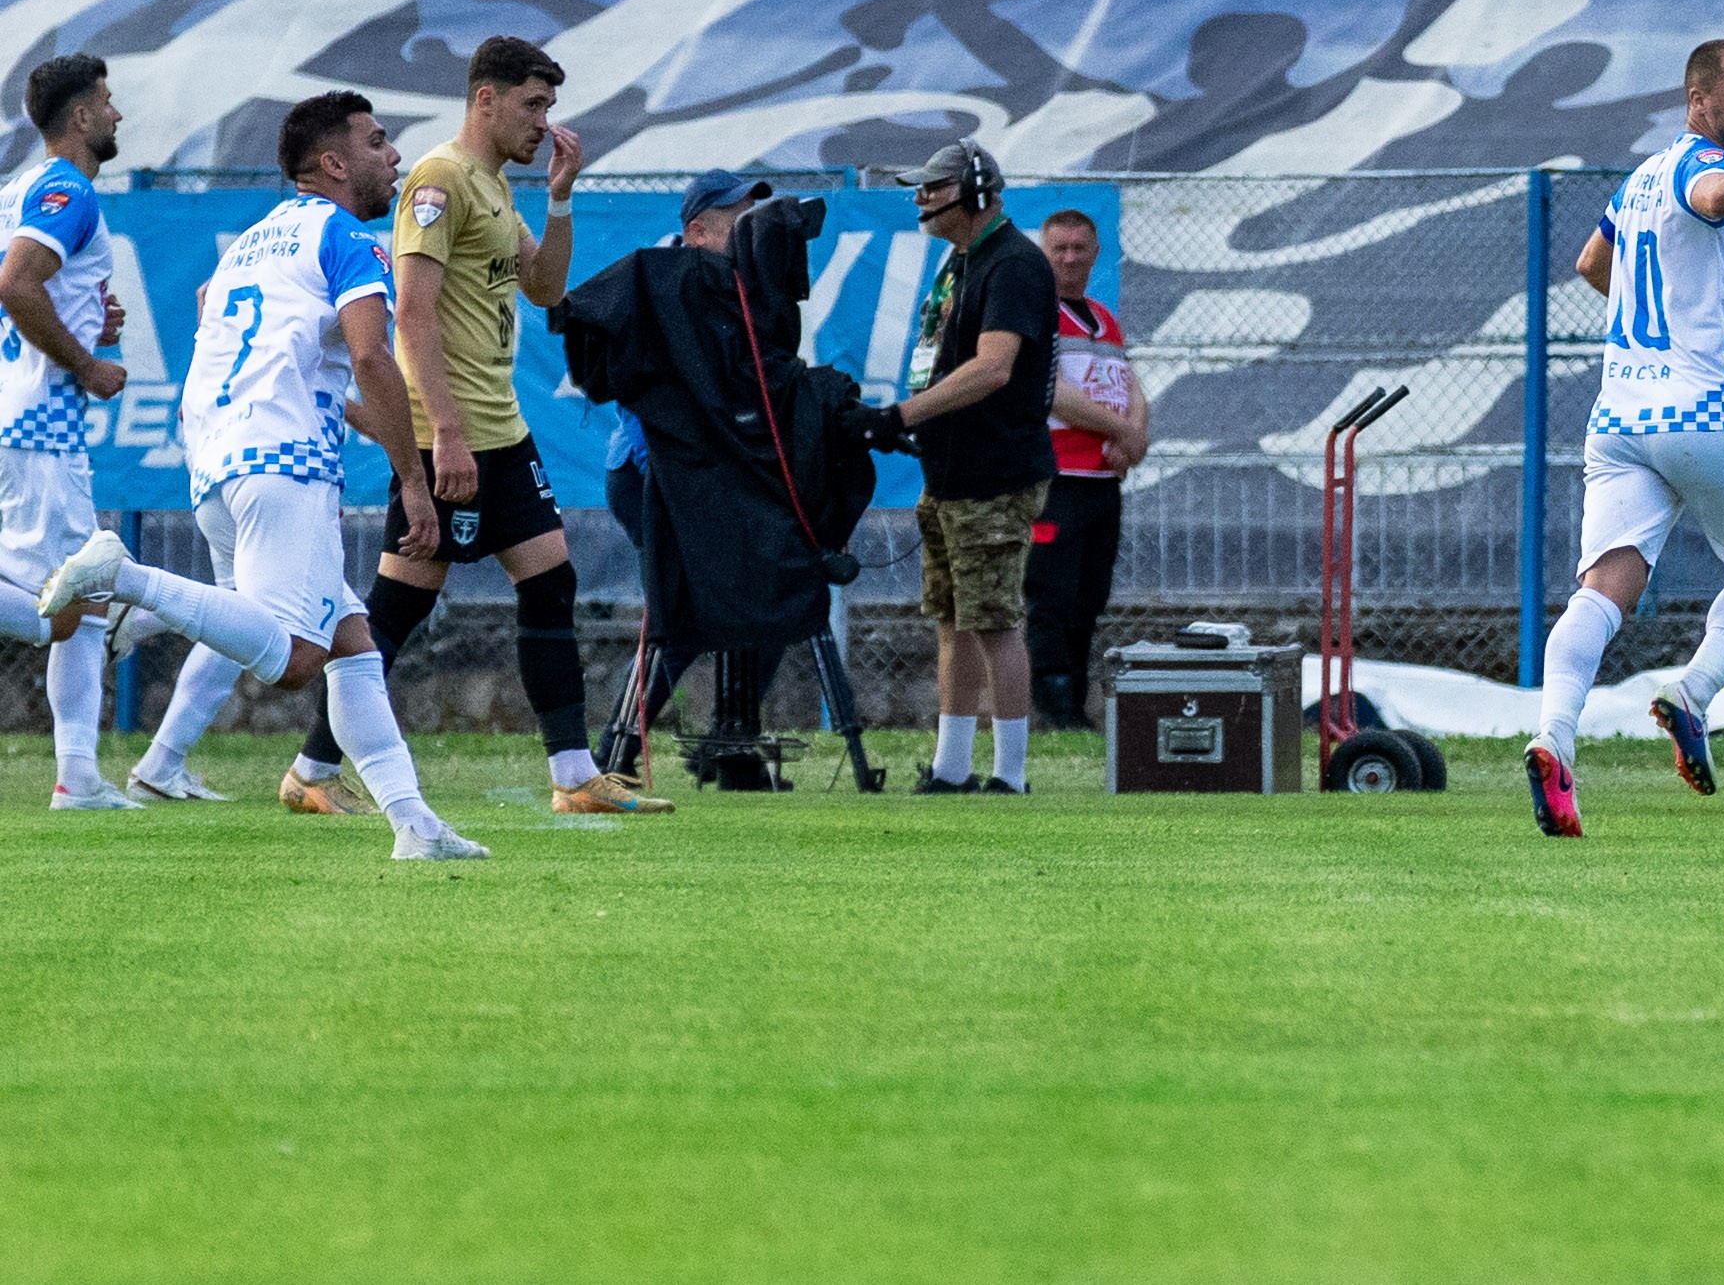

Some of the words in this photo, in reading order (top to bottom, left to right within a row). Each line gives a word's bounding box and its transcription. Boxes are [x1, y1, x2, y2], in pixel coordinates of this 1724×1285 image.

[216, 283, 264, 408] 7
[1606, 229, 1672, 352] 10
[321, 597, 336, 631] 7
